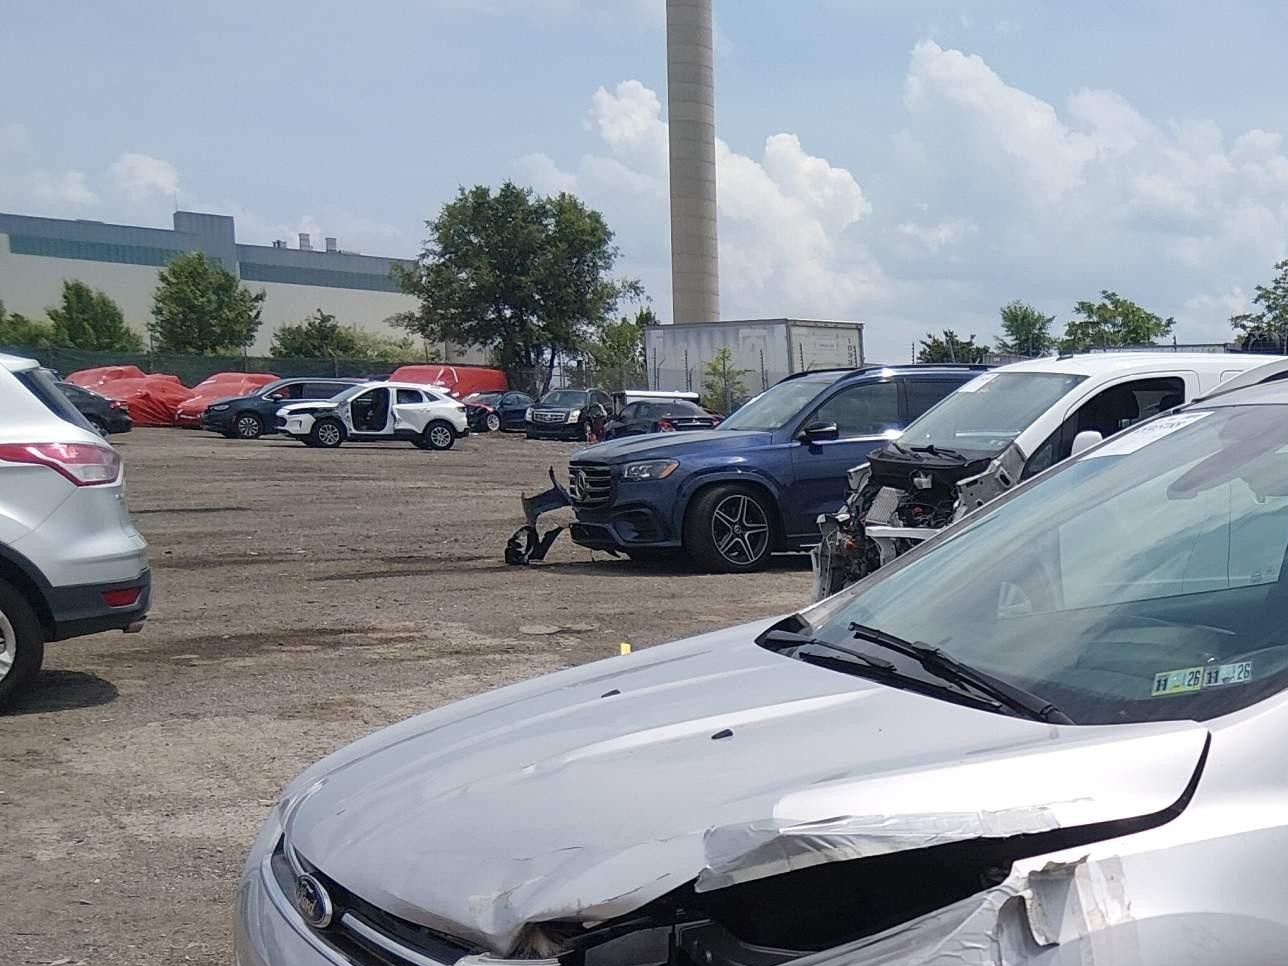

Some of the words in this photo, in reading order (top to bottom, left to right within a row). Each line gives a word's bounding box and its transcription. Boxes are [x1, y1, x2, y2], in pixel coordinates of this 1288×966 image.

[1156, 677, 1168, 691] 11
[1187, 670, 1200, 686] 26
[1206, 669, 1219, 685] 11
[1237, 663, 1250, 680] 26
[297, 880, 318, 917] Ford
